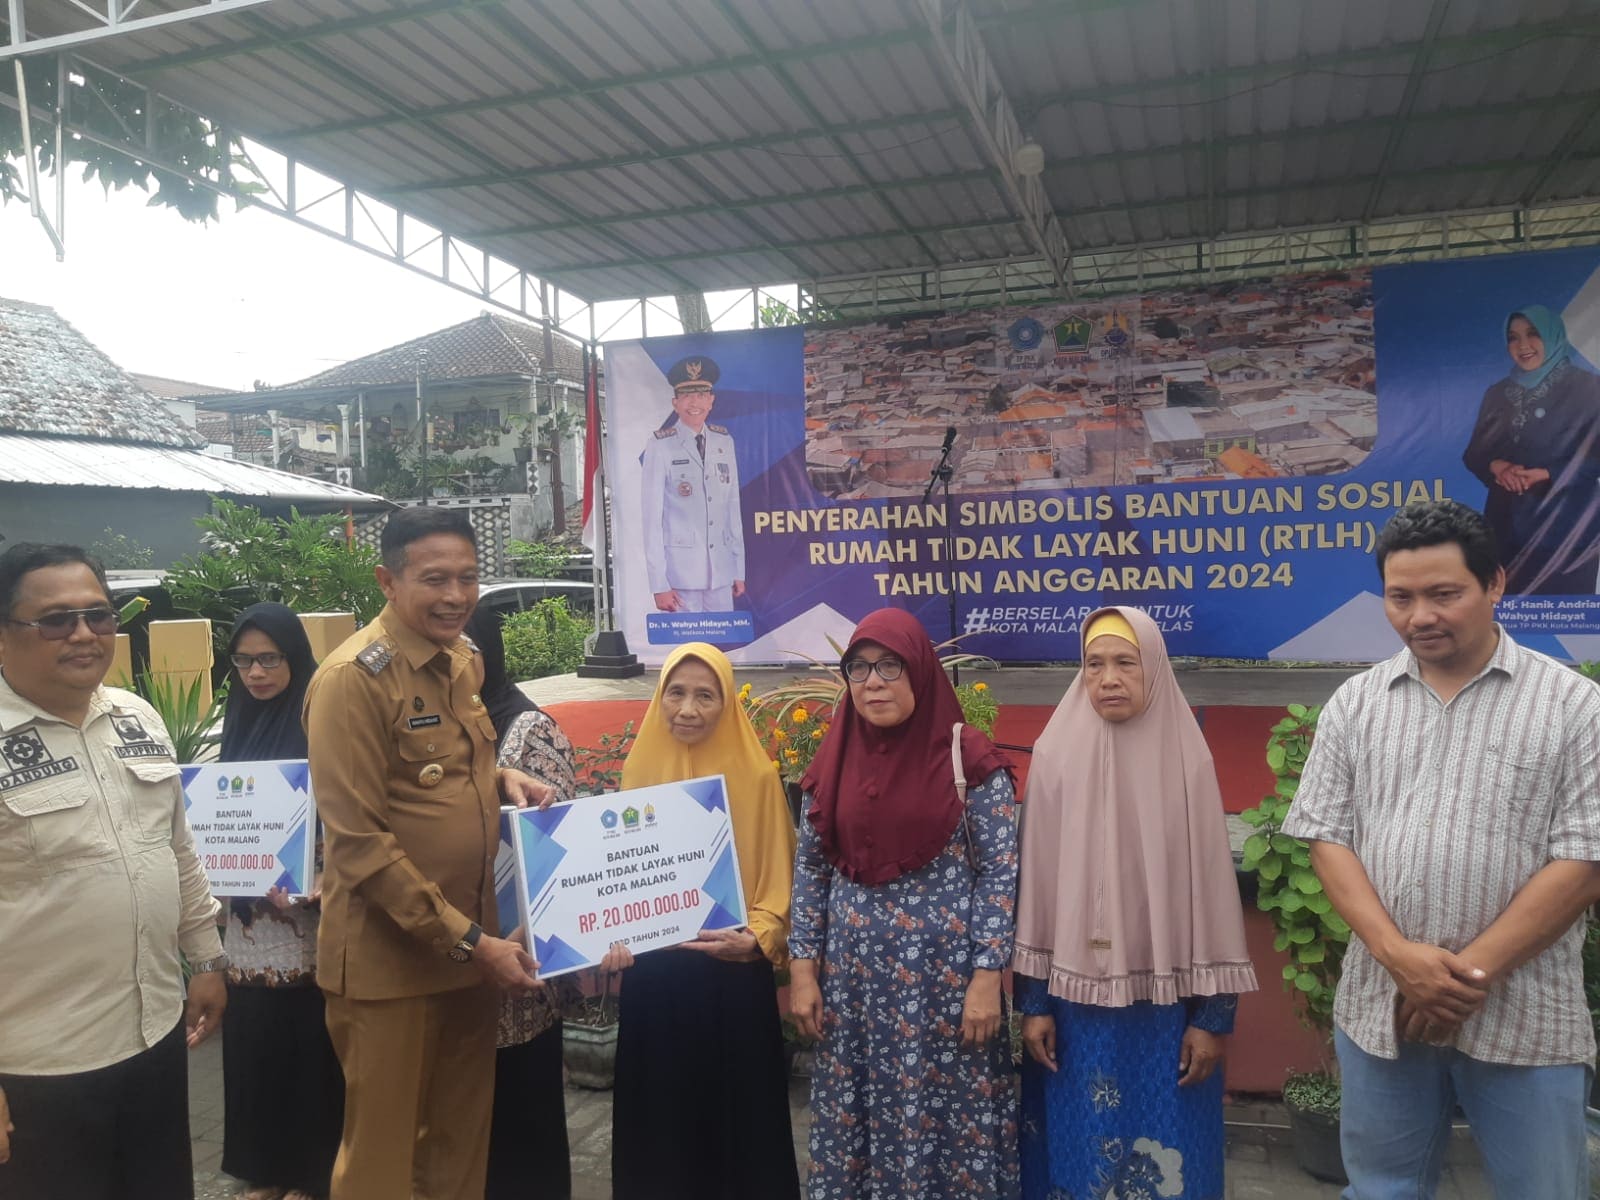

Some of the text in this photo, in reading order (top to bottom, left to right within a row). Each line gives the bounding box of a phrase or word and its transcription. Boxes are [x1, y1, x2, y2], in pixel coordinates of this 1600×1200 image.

[754, 479, 1452, 534] PENYERAHAN SIMBOLIS BANTUAN SOSIAL
[810, 521, 1377, 565] RUMAH TIDAK LAYAK HUNI (RTLH)
[874, 562, 1294, 596] TAHUN ANGGARAN 2024
[1134, 604, 1195, 618] NTUK
[1503, 600, 1518, 610] Hj.
[1521, 600, 1554, 609] Hanik
[671, 621, 698, 629] Wahyu
[1498, 612, 1586, 621] Wahyu Hidayat
[989, 622, 1028, 633] KOTA
[1033, 622, 1081, 633] MALA
[0, 760, 72, 788] DANDUNG
[216, 810, 253, 819] BANTUAN
[191, 822, 284, 831] MAH TIDAK LAYAK HUNI
[205, 835, 260, 844] KOTA MALANG
[607, 843, 660, 863] BANTUAN
[205, 854, 274, 870] 20.000.000.00
[561, 849, 705, 888] RUMAH TIDAK LAYAK HUNI
[597, 871, 677, 897] KOTA MALANG
[578, 888, 700, 934] RP. 20.000.000.00
[632, 931, 660, 943] TAHUN
[662, 925, 680, 937] 2024
